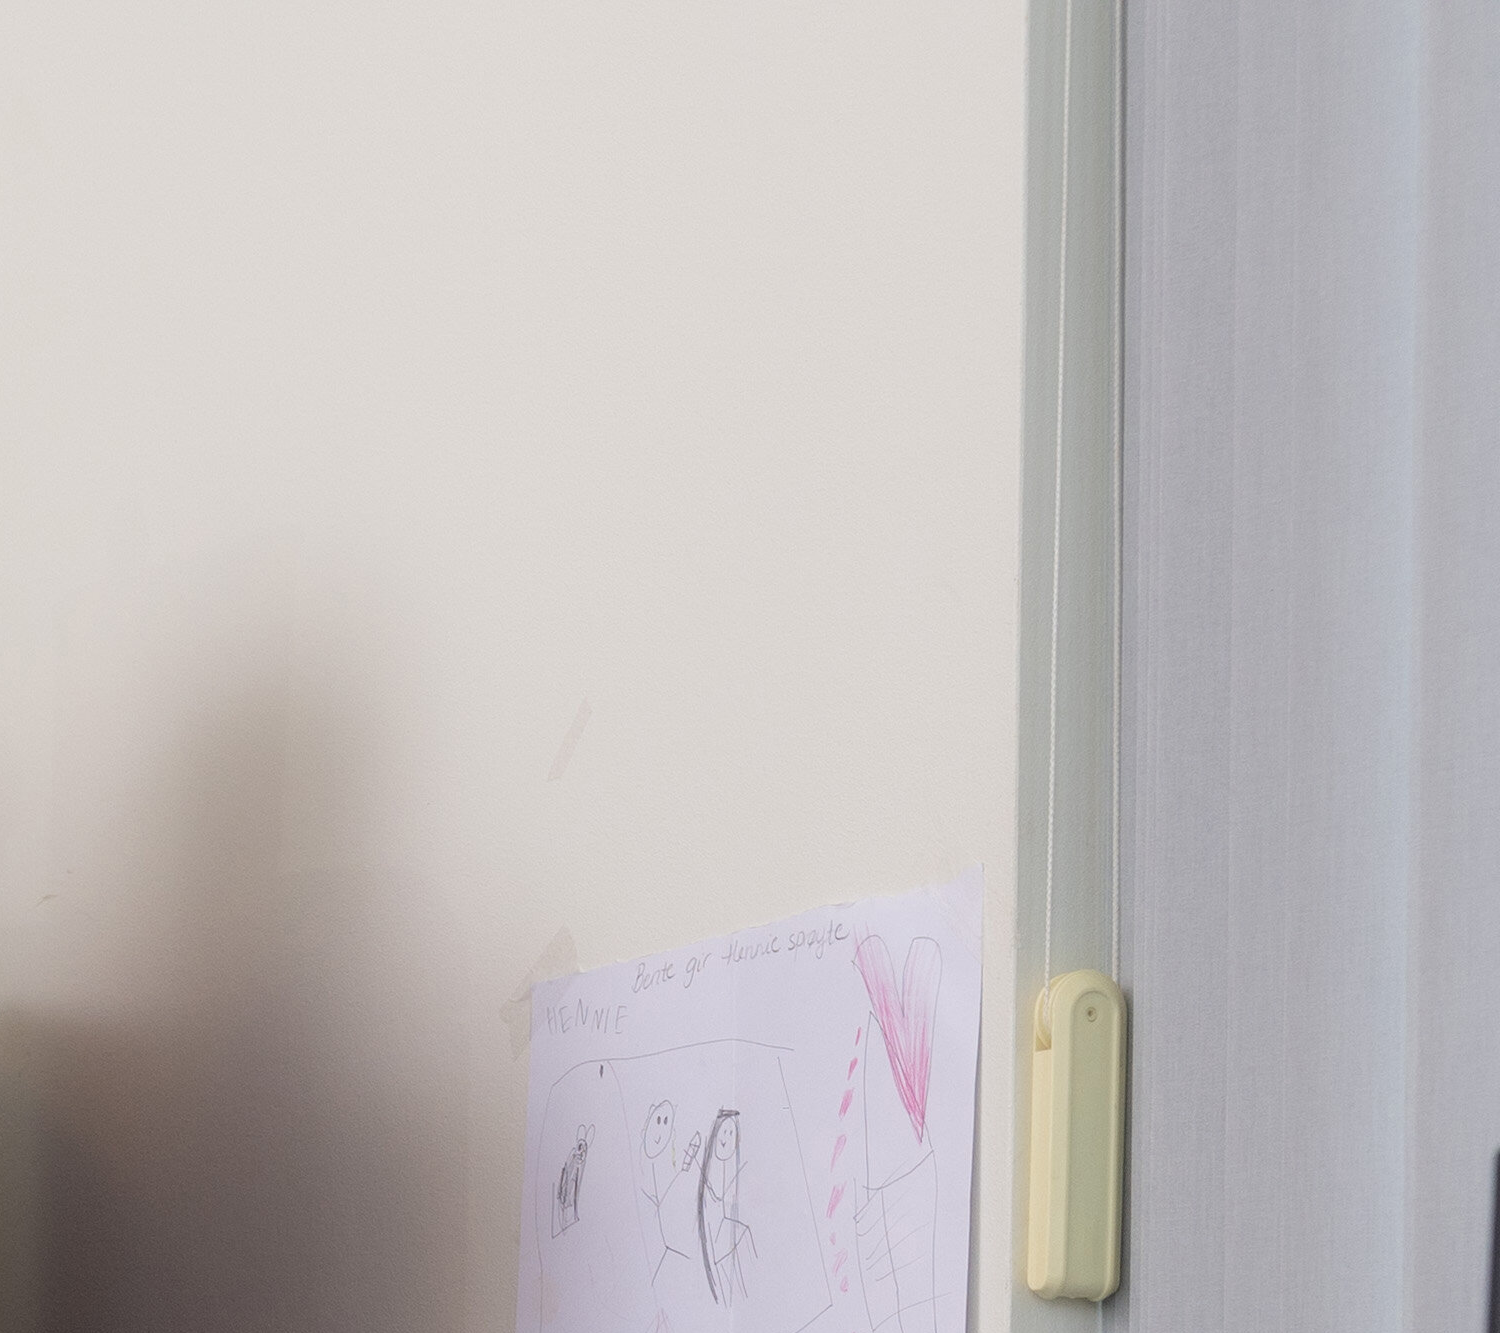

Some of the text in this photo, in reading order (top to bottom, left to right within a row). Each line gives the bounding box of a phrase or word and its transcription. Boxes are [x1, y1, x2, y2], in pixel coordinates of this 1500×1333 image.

[632, 962, 676, 993] Bente
[684, 951, 711, 989] gir
[546, 999, 629, 1034] HENNIE
